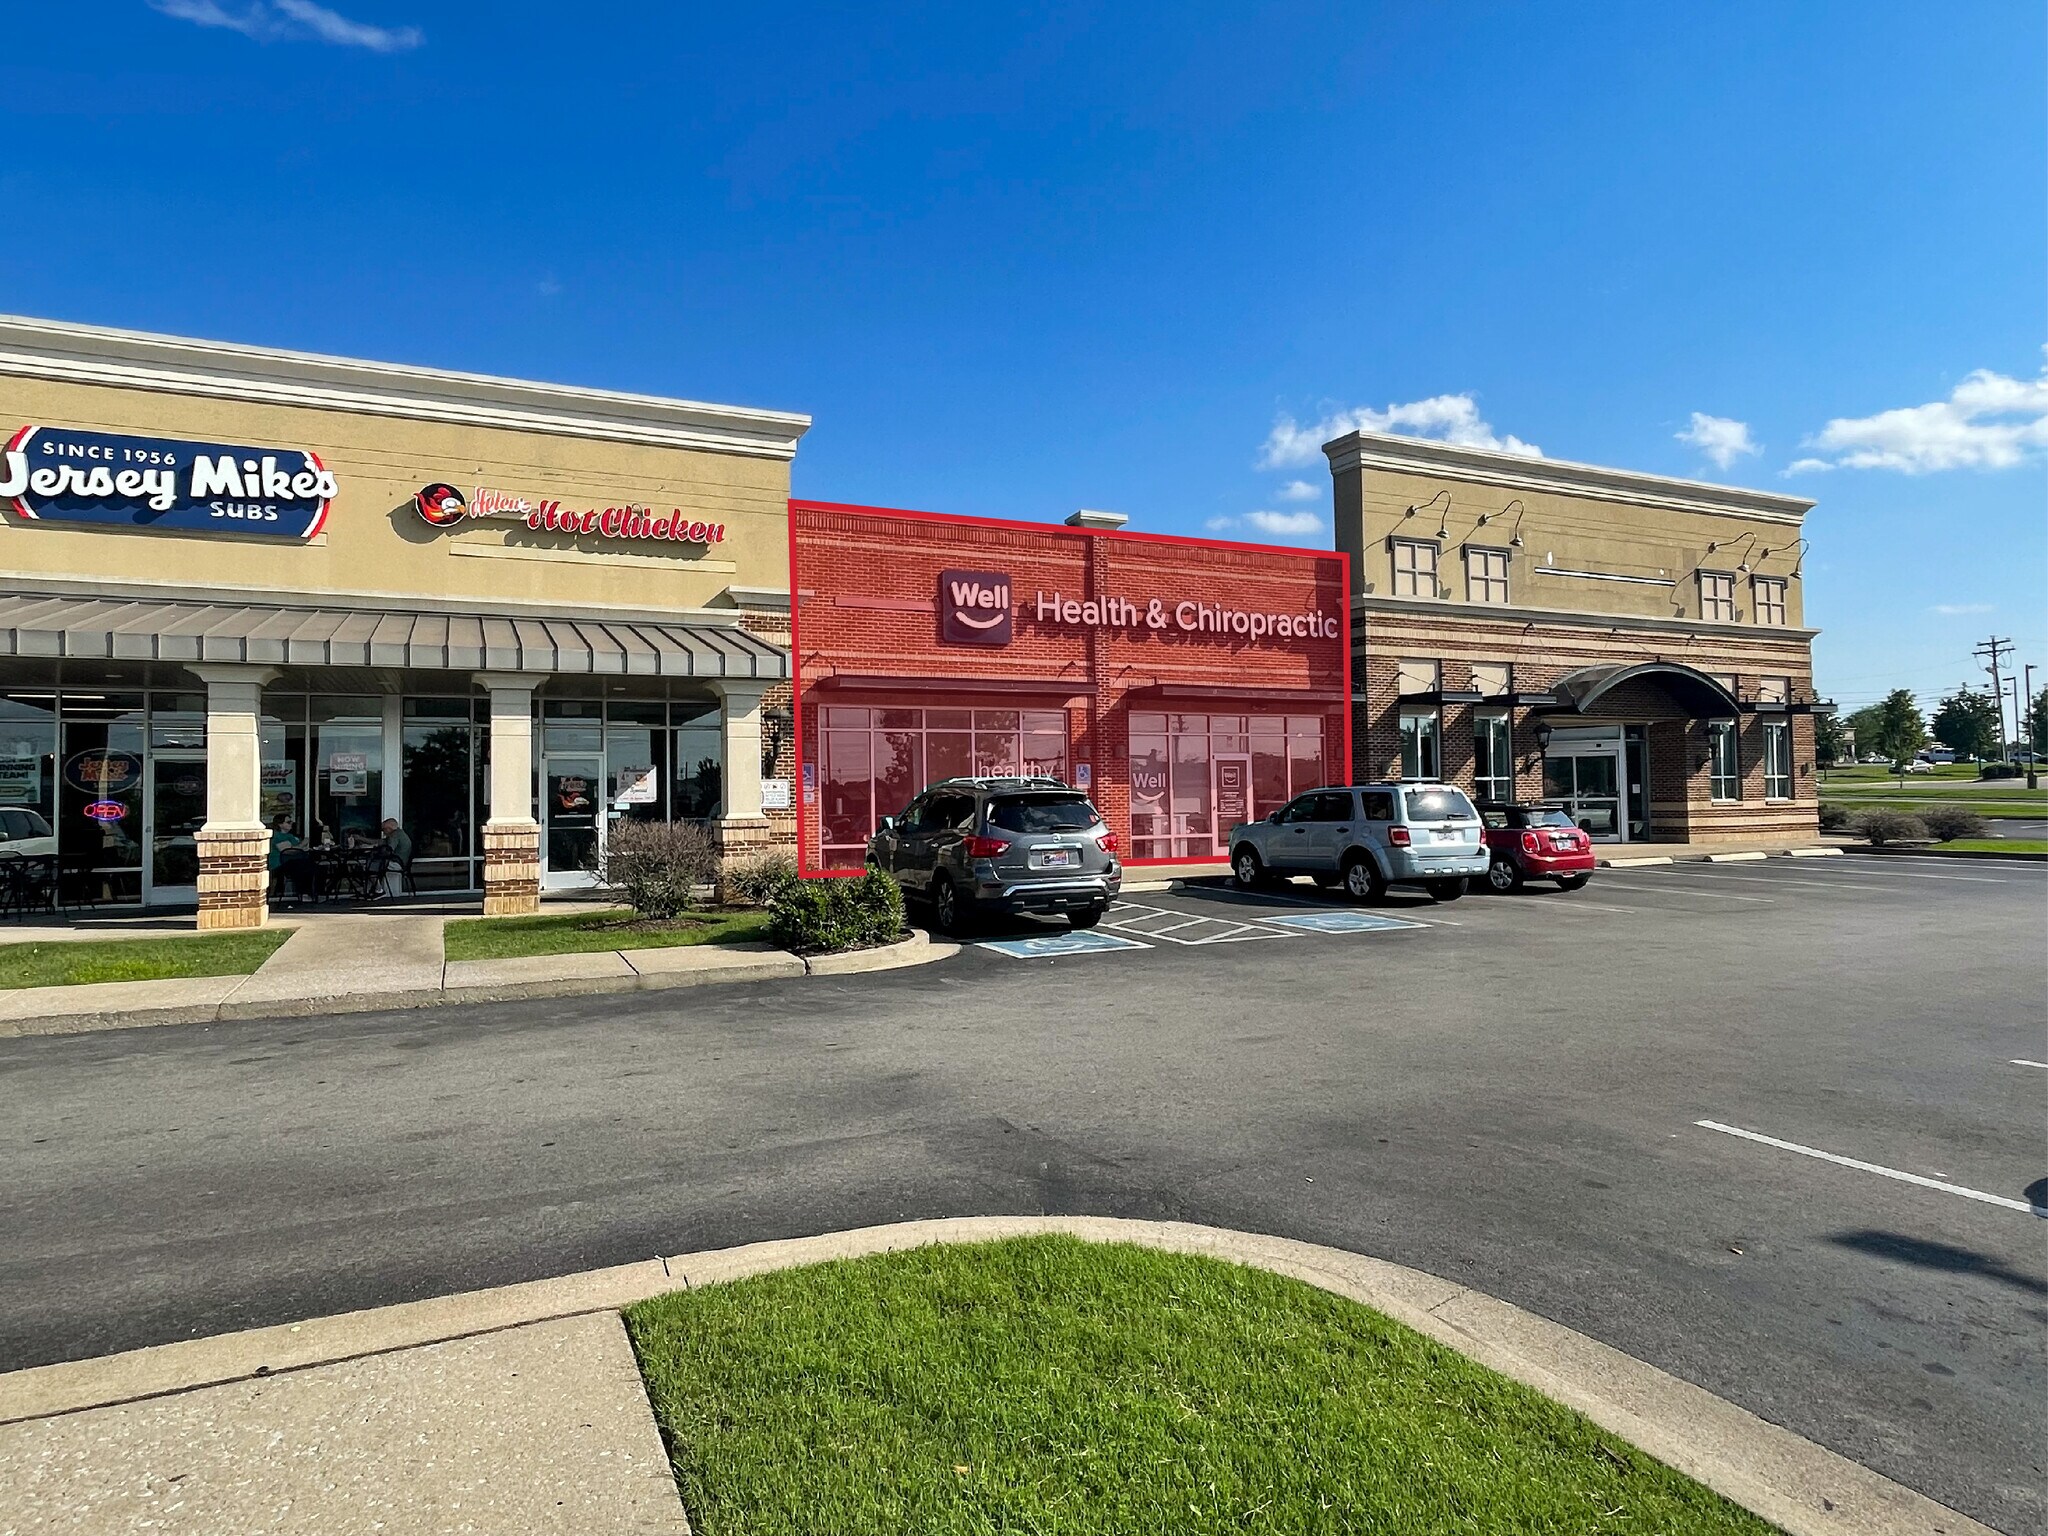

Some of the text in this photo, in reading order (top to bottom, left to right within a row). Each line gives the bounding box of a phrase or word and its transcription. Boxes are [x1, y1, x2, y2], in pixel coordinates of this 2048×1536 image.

[42, 441, 177, 466] SINCE 1956
[0, 451, 339, 511] Jersey Mike's
[209, 501, 279, 521] SUBS
[527, 500, 600, 535] Hot
[599, 507, 726, 545] Chicken
[950, 580, 1009, 610] Well
[1036, 590, 1339, 641] Health & Chiropractic
[978, 760, 1055, 779] healthy
[1132, 772, 1166, 789] Well
[83, 803, 126, 819] OPEN
